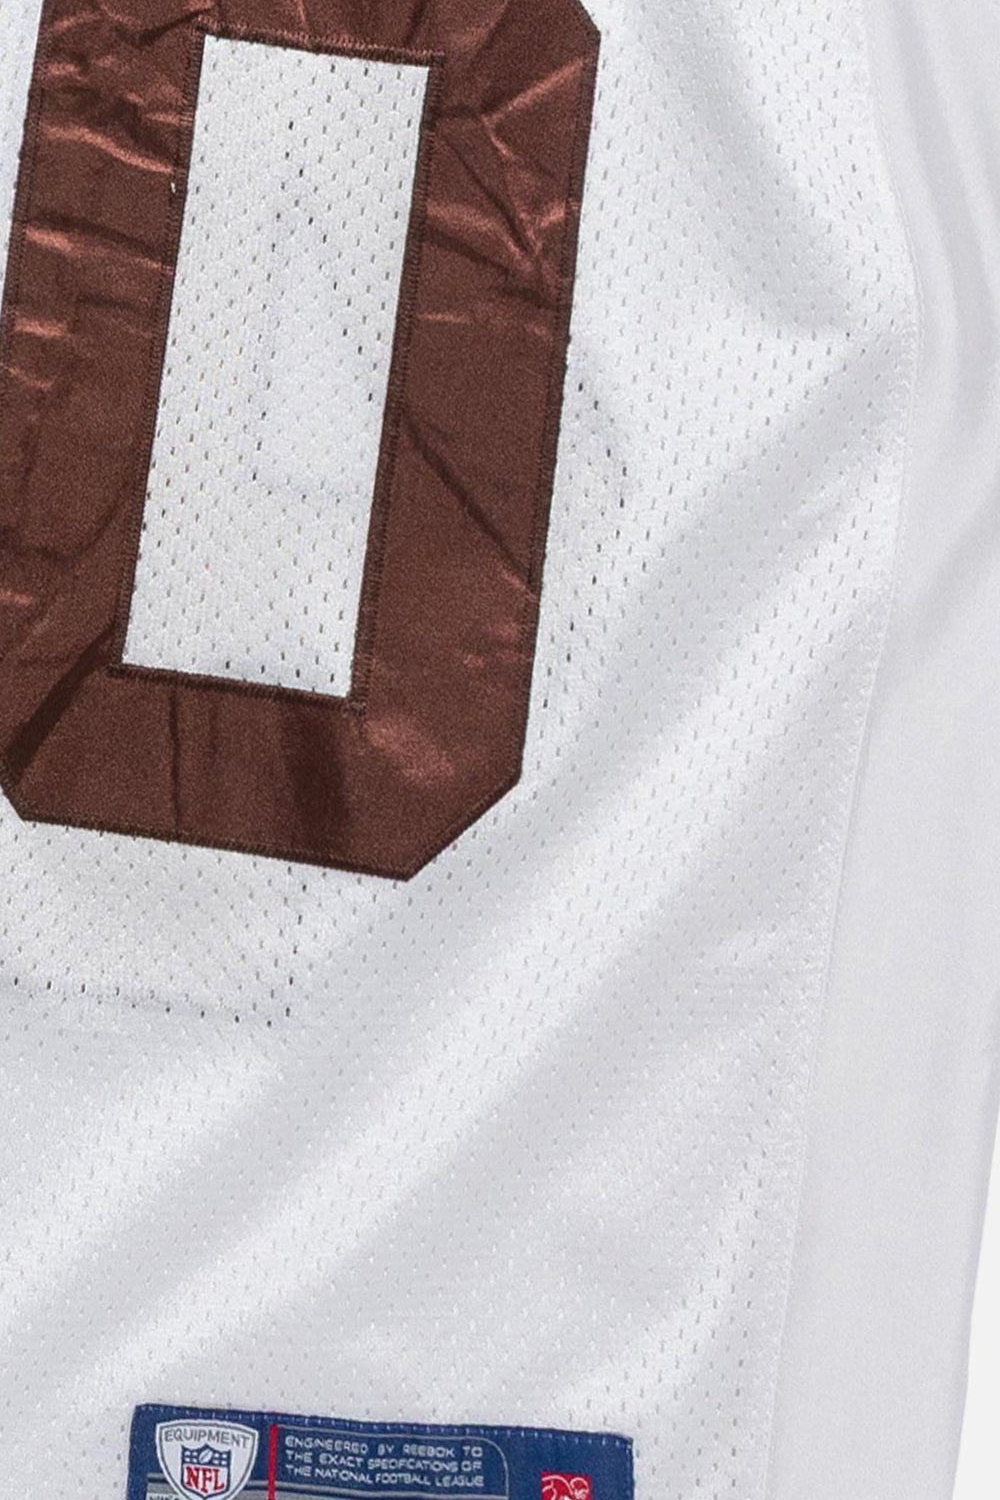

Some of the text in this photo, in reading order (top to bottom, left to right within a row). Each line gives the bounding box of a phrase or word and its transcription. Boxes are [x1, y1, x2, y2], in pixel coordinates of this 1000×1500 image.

[163, 1427, 251, 1450] EQUIPMENT
[285, 1449, 313, 1463] THE
[319, 1452, 364, 1468] EXACT
[461, 1460, 482, 1472] OF
[377, 1443, 395, 1456] BY
[402, 1444, 456, 1458] REEBOK
[462, 1445, 483, 1458] TO
[184, 1466, 225, 1494] NFL
[285, 1464, 484, 1488] THE NATIONAL FOOTBALL LEAGUE
